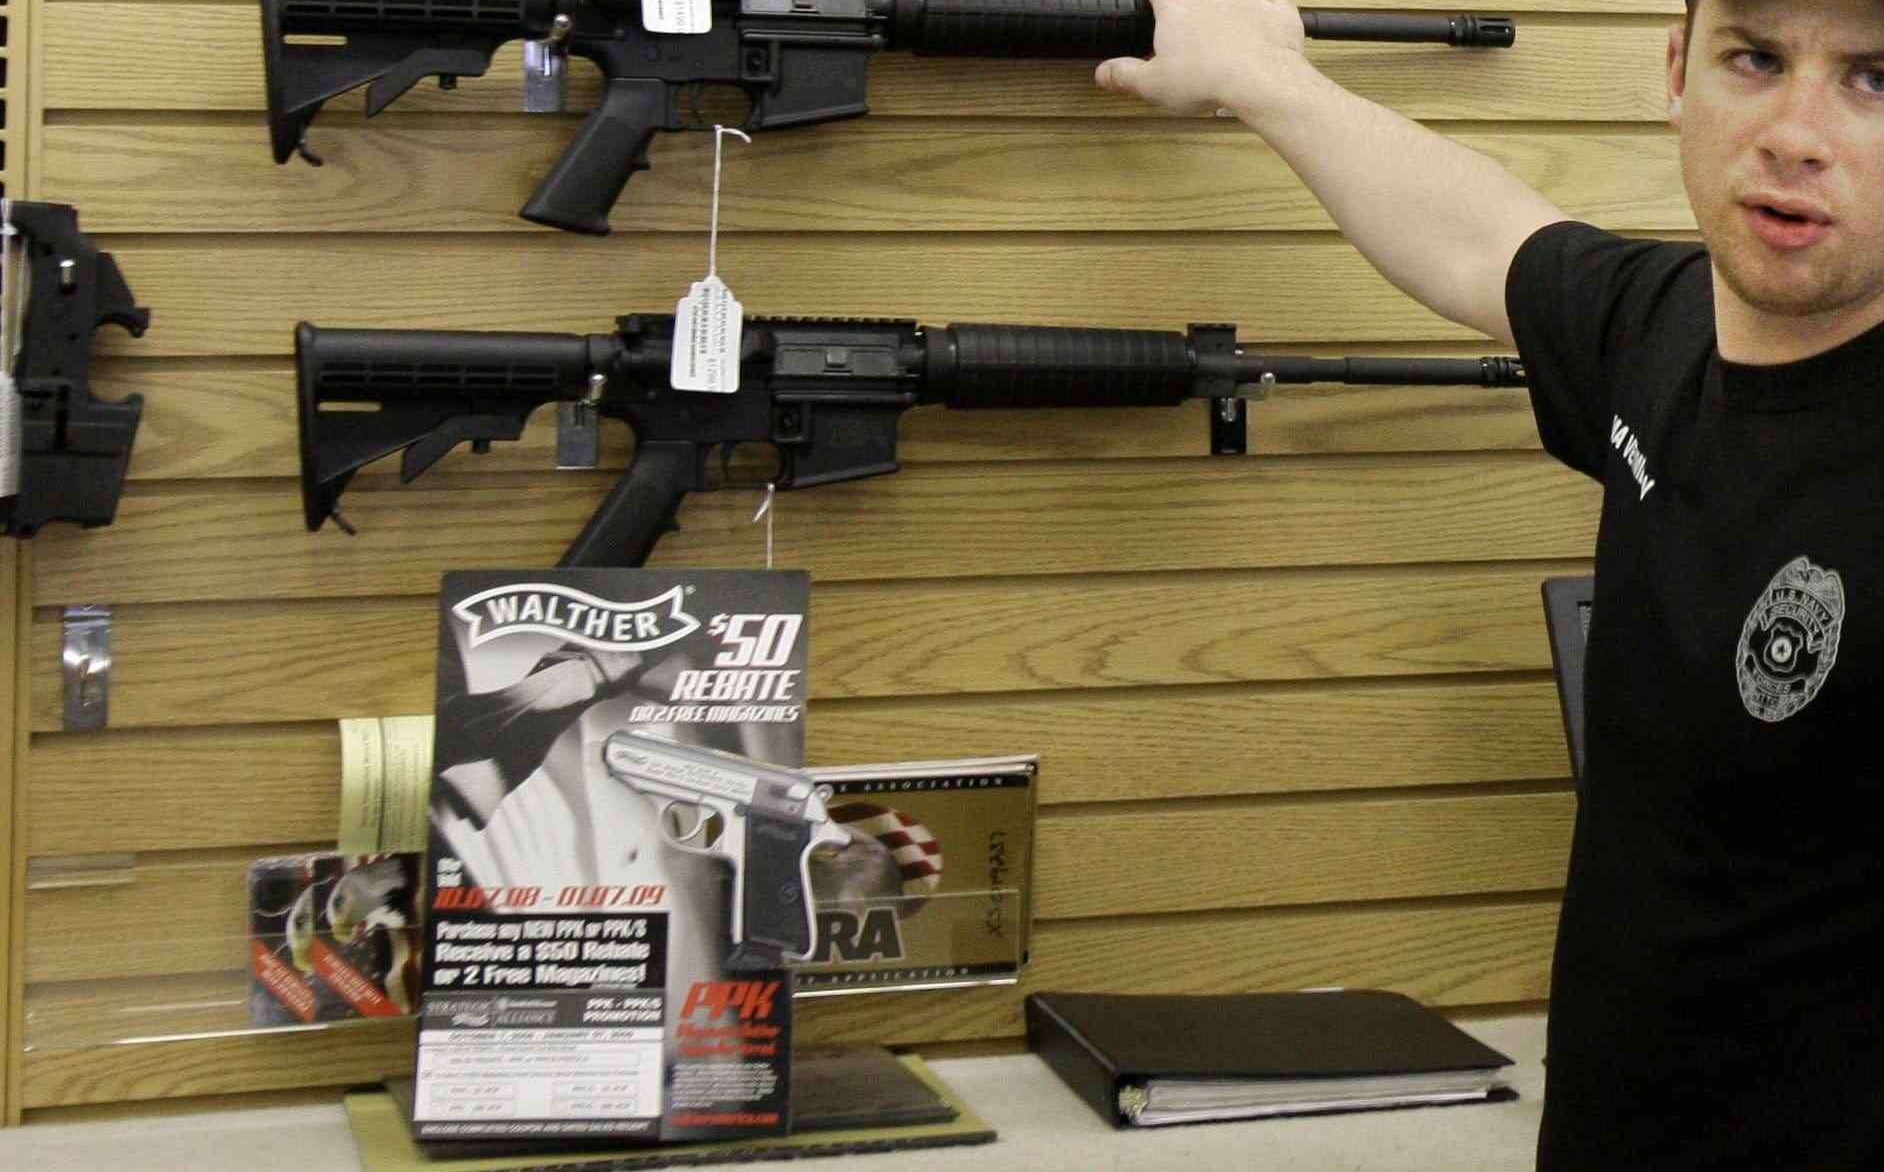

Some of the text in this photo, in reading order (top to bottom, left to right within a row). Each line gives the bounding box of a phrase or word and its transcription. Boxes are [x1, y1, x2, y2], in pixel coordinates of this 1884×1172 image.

[486, 593, 661, 641] WALTHER
[1770, 603, 1820, 634] SECURITY
[1801, 592, 1830, 622] NAVY
[706, 612, 803, 668] $50
[669, 669, 801, 702] REBATE
[1752, 669, 1792, 694] FORCES
[653, 706, 668, 722] 2
[668, 705, 707, 722] FREE
[705, 705, 800, 723] MAGAZINES
[864, 777, 1003, 793] ASSOCIATION
[557, 885, 665, 907] 01.07.09
[436, 919, 648, 941] Purchase any NEW PPK or PPK/S
[813, 908, 903, 962] RA
[435, 940, 650, 963] Receive a $50 Rebate
[433, 963, 648, 986] or 2 Free Magazines!
[831, 967, 969, 984] APPLICATION
[680, 980, 782, 1020] PPK
[583, 1010, 662, 1023] PROMOTION
